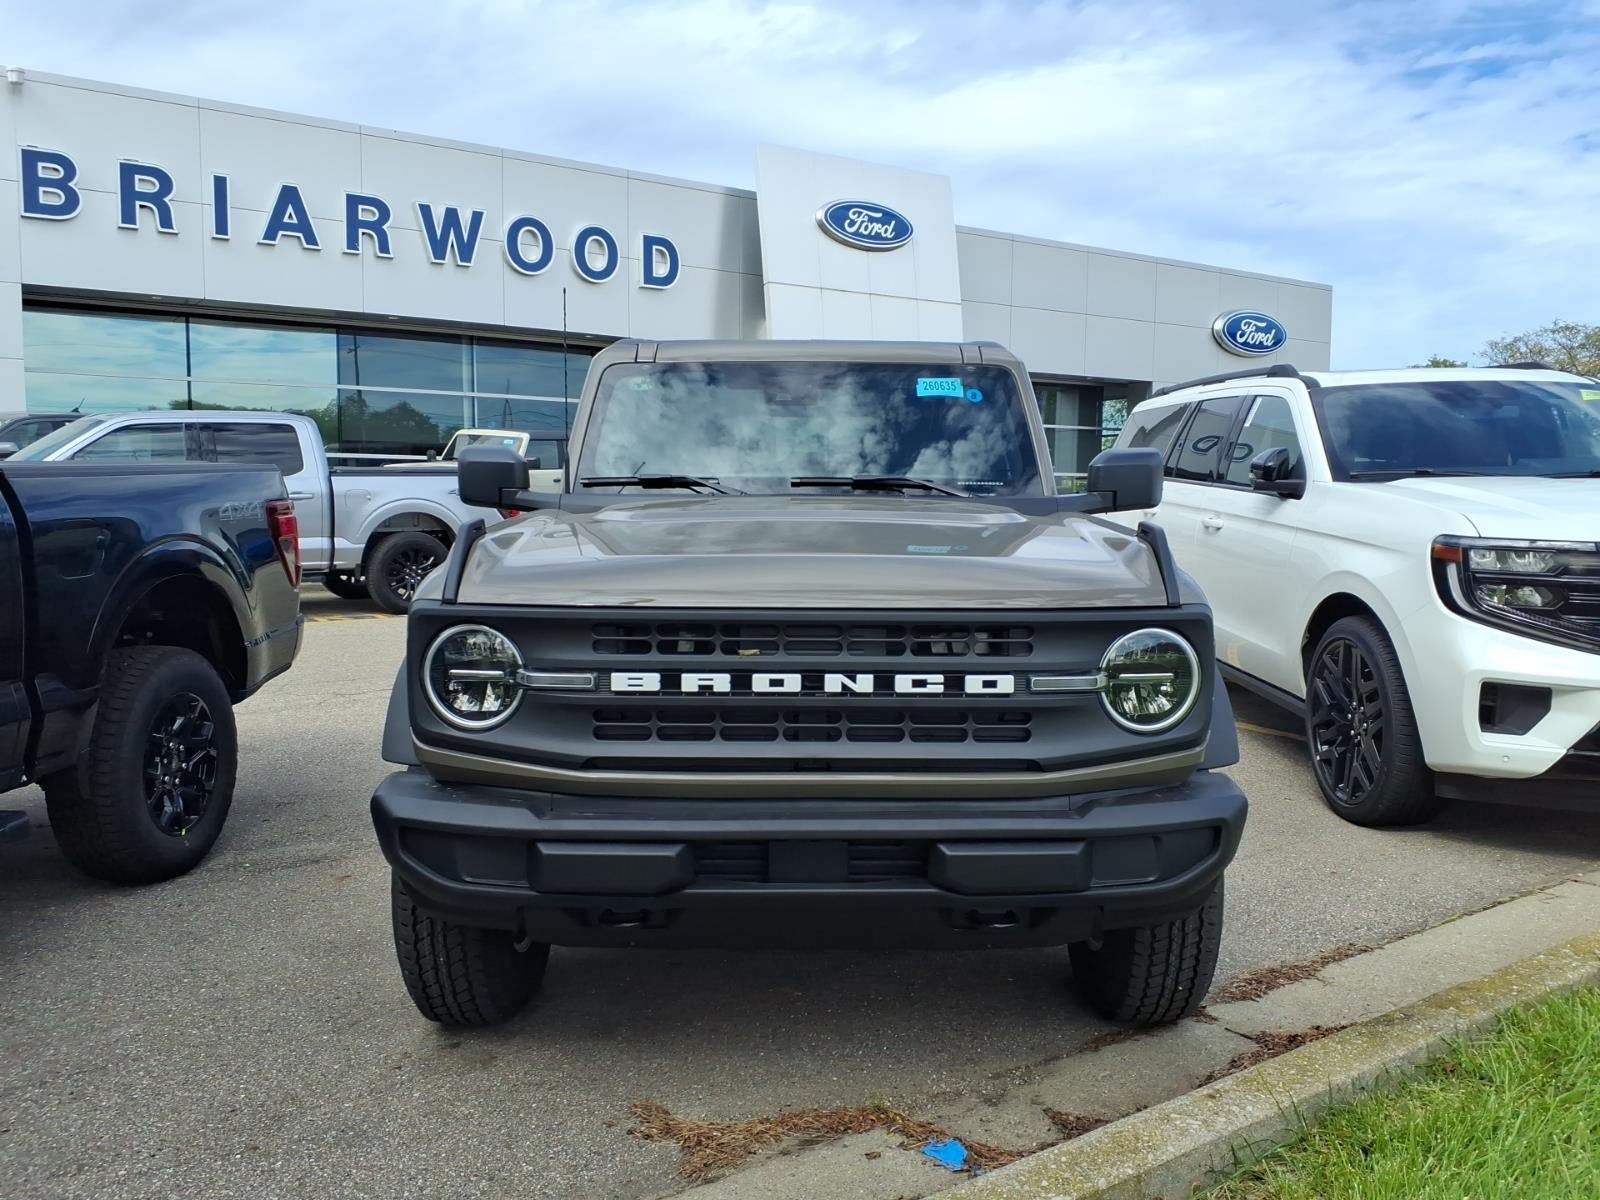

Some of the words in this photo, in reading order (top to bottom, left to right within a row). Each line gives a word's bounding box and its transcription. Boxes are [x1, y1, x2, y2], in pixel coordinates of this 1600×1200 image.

[20, 146, 682, 291] BRIARWOOD
[844, 208, 895, 238] Ford
[1236, 319, 1276, 346] Ford
[922, 381, 957, 391] 260635
[610, 672, 1014, 693] BRONCO
